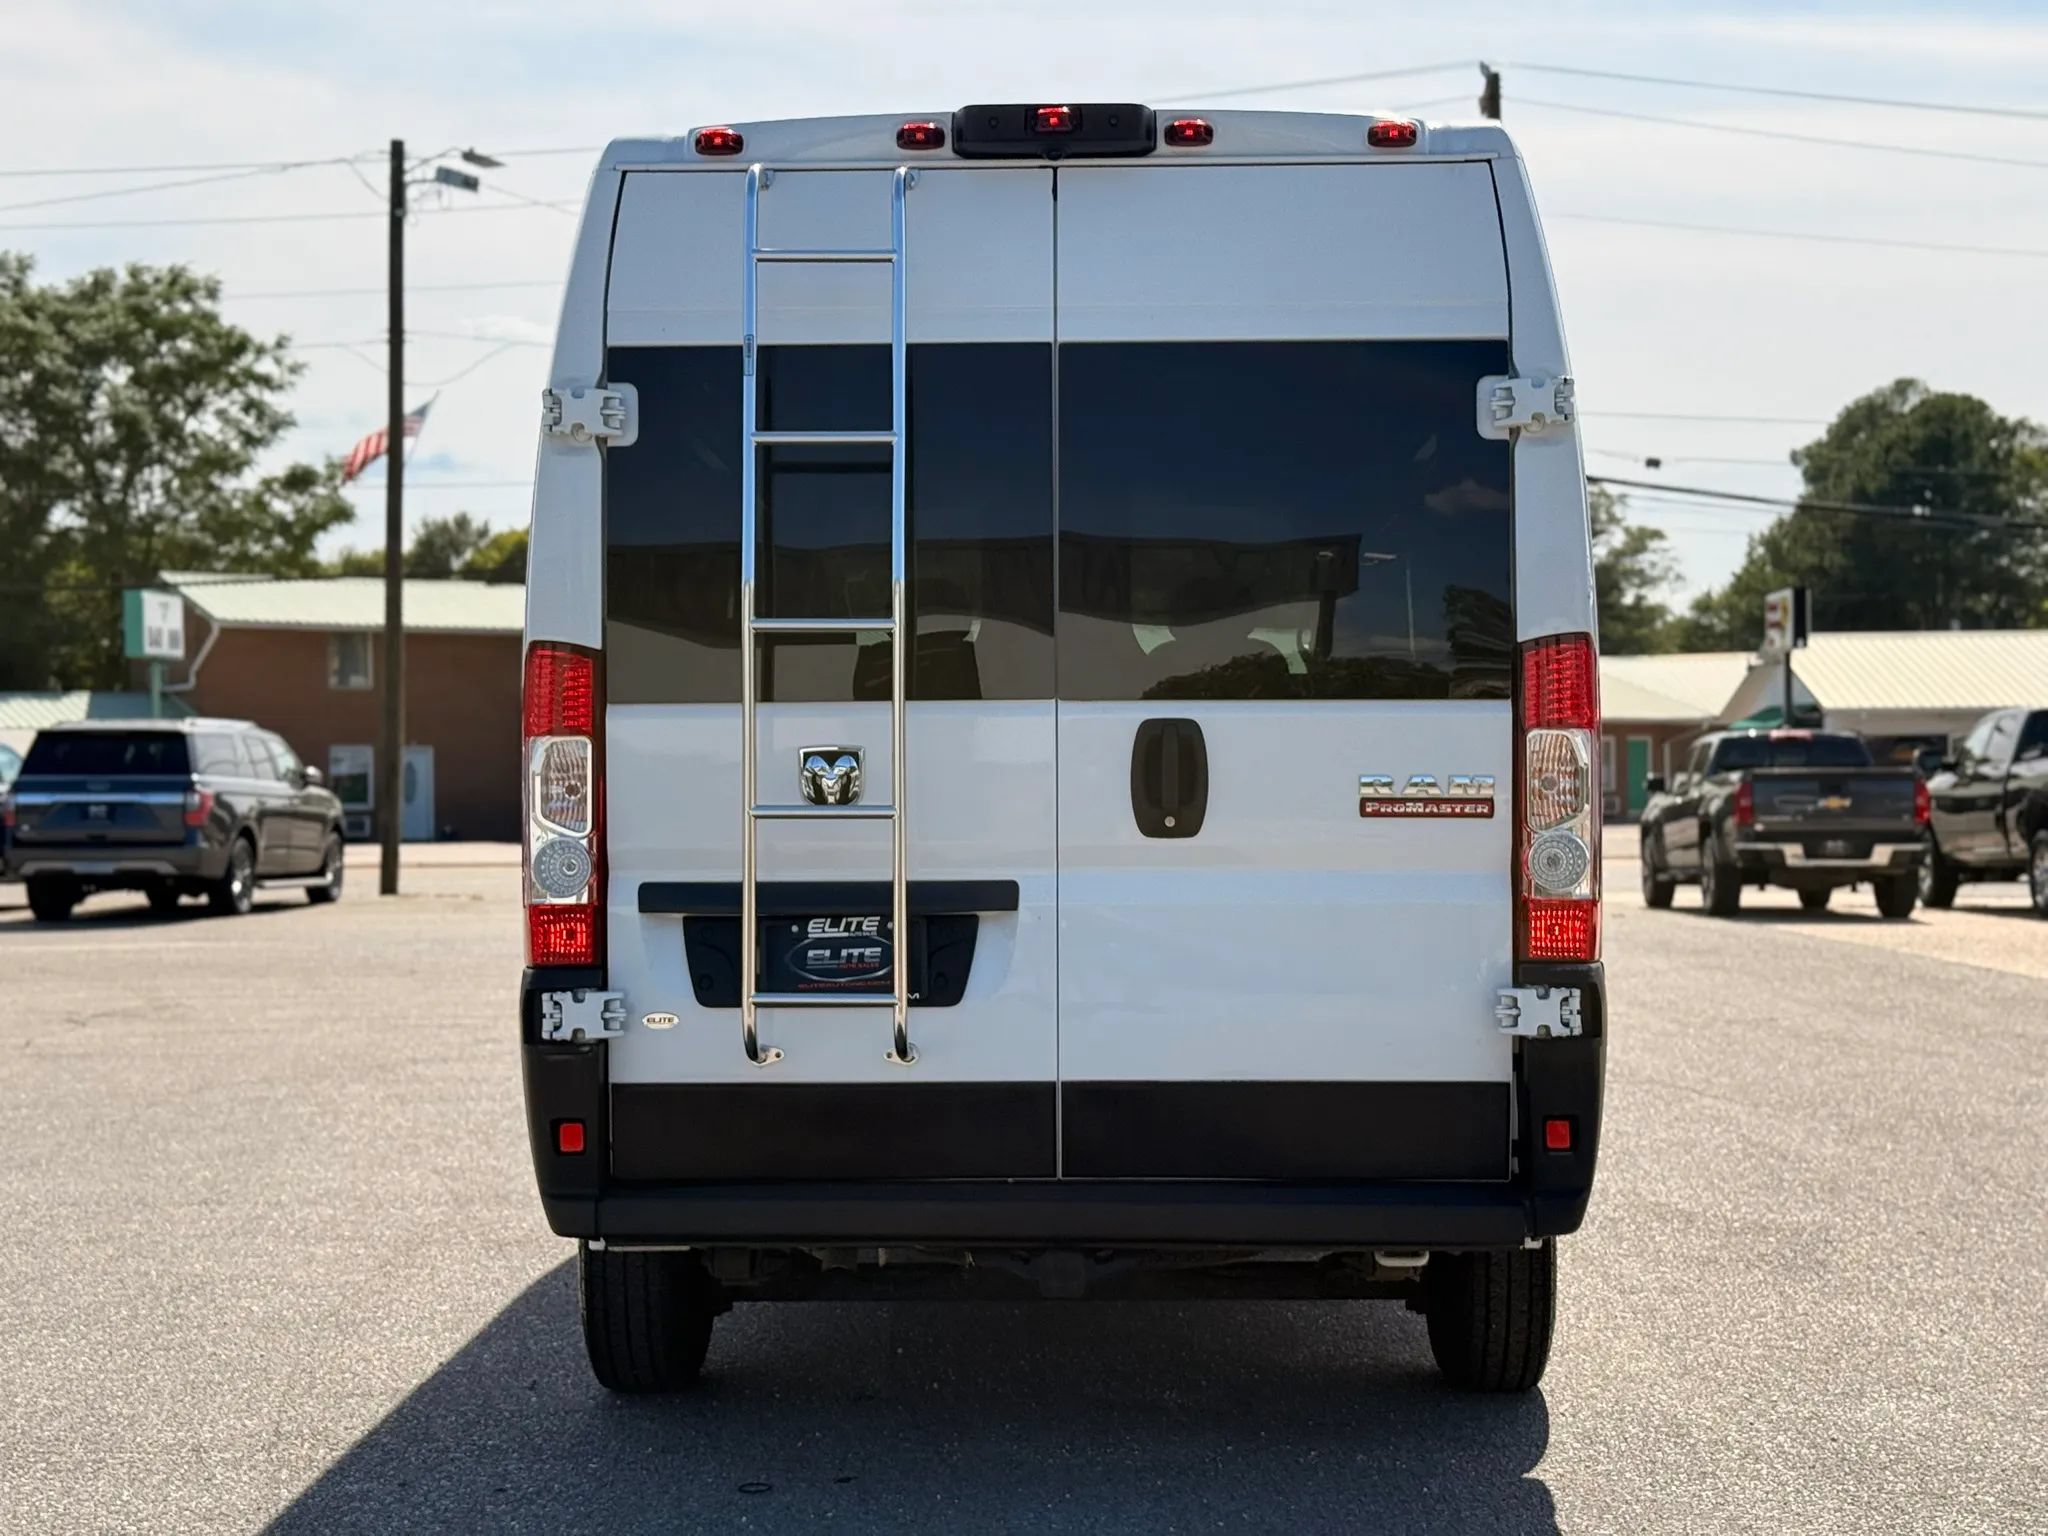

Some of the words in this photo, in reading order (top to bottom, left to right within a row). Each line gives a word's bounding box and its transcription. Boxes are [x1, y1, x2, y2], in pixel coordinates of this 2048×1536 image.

[1359, 775, 1495, 796] RAM
[807, 916, 881, 933] ELITE
[806, 947, 882, 965] ELITE
[646, 1016, 674, 1024] ELITE
